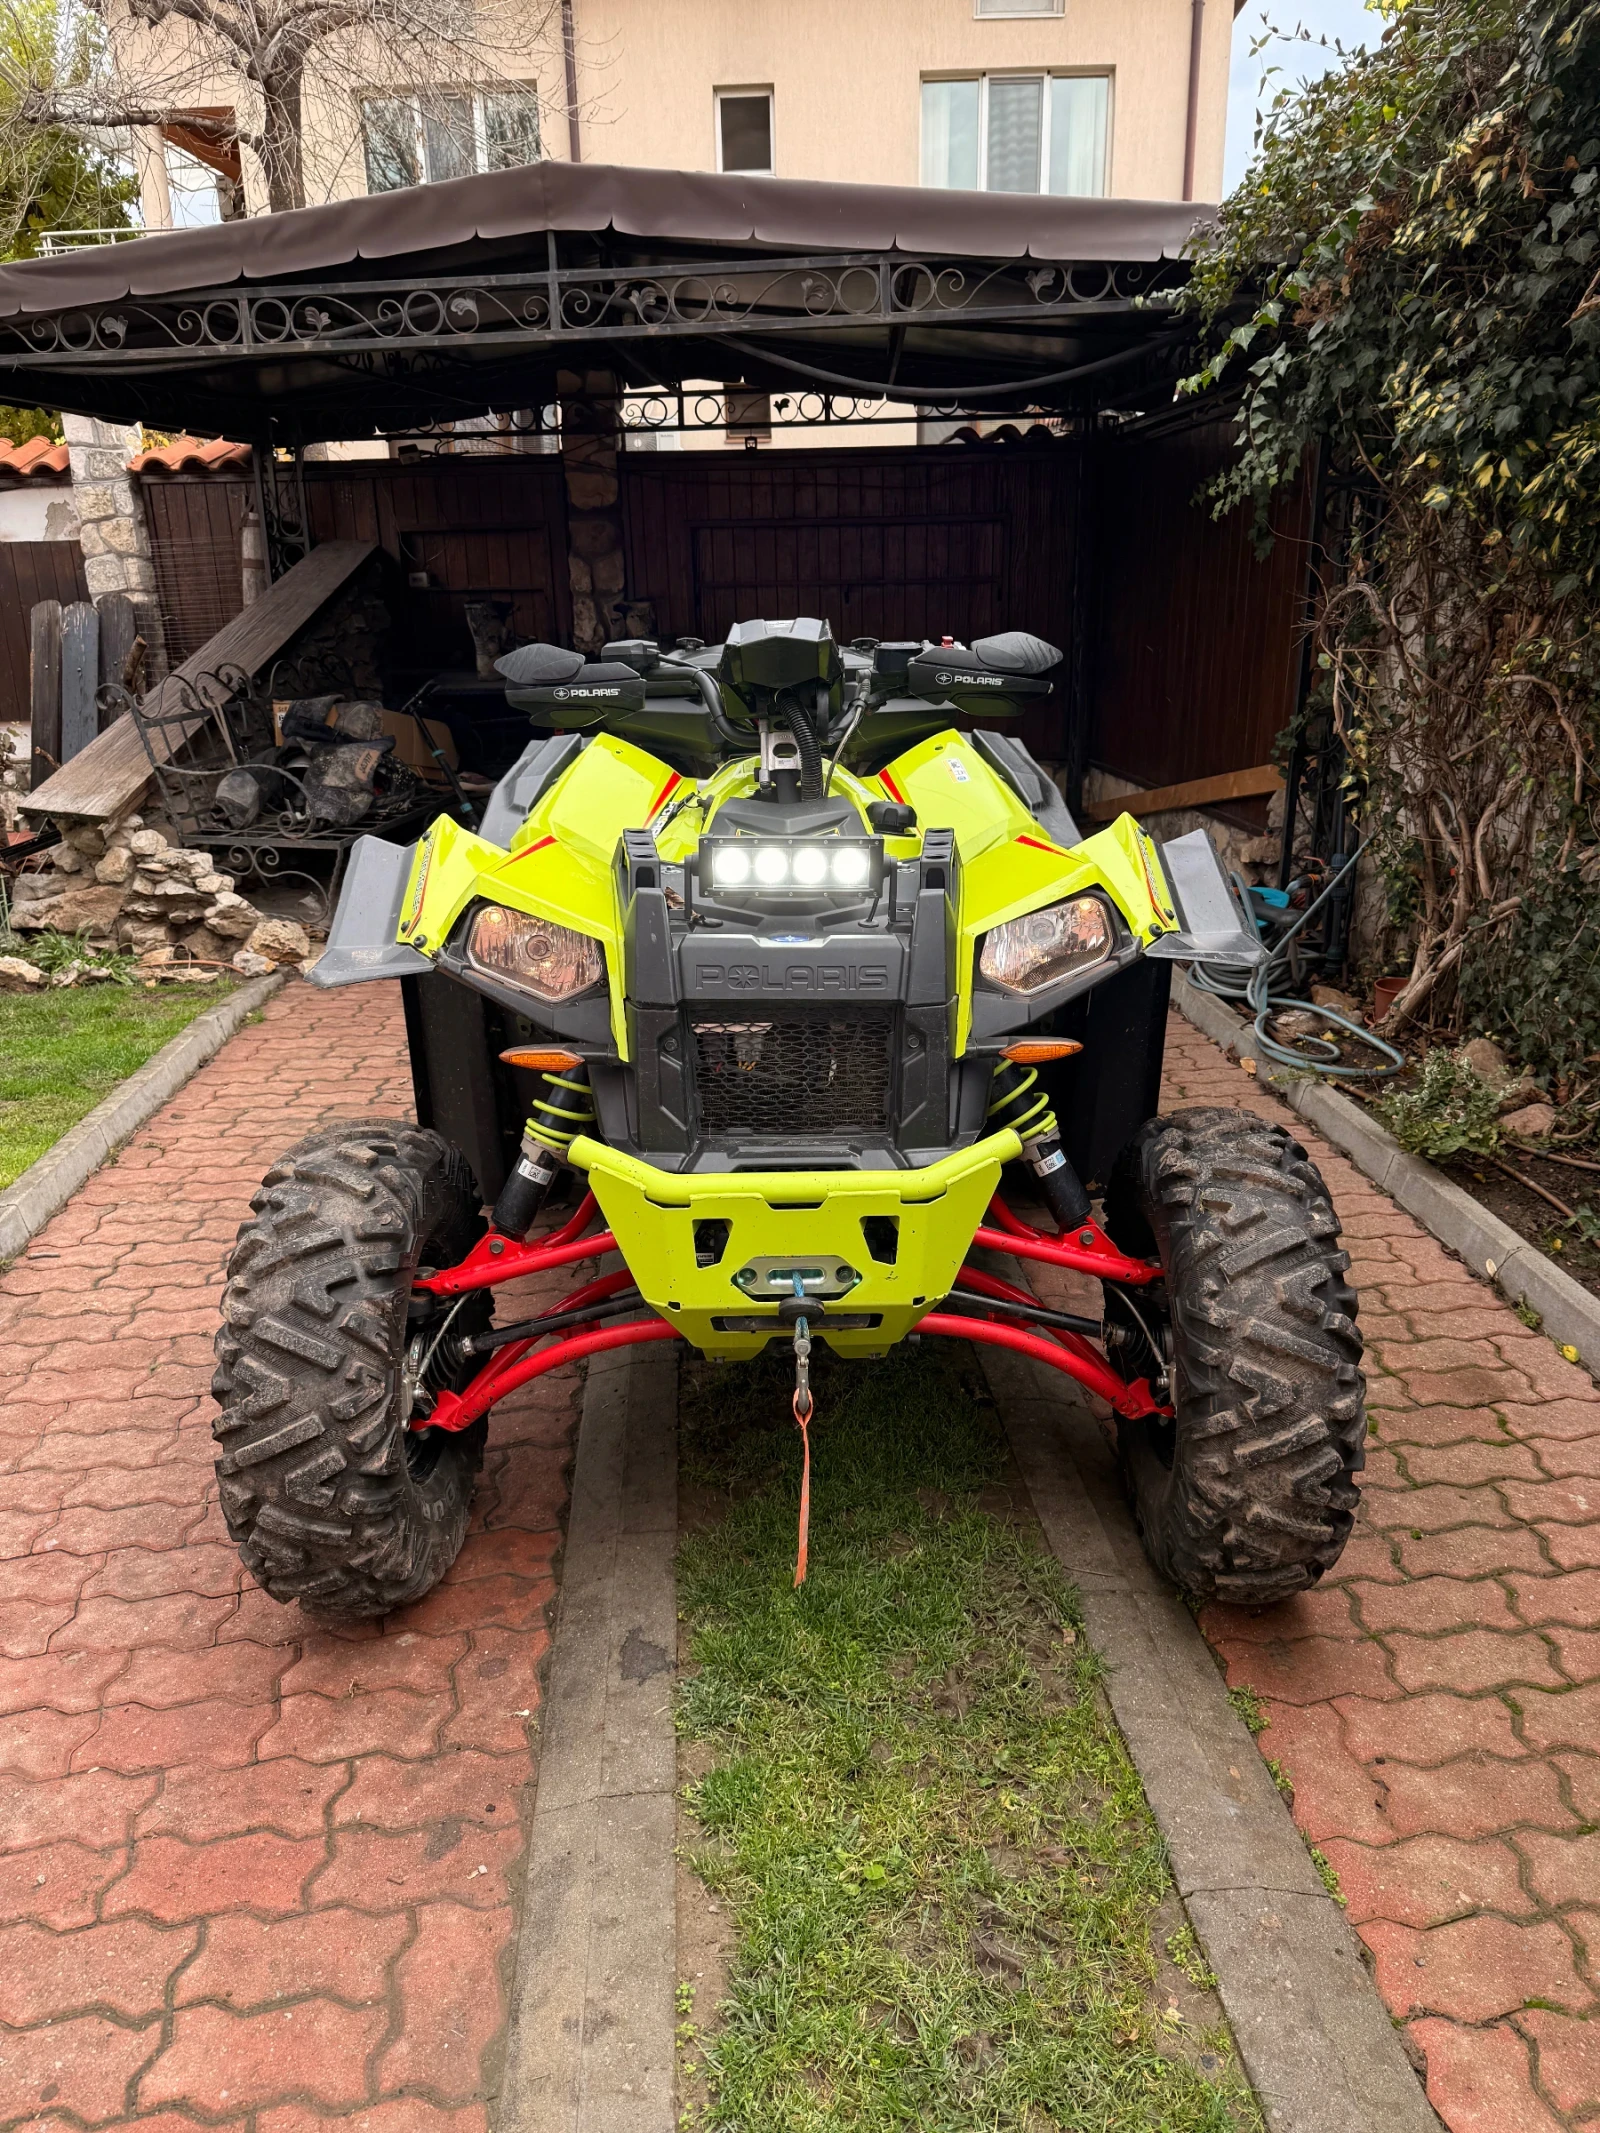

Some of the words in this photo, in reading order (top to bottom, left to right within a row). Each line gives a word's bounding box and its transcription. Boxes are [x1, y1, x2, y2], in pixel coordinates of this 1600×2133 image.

[954, 675, 1004, 686] POLARIS
[570, 688, 621, 697] POLARIS
[695, 964, 889, 991] POLARIS
